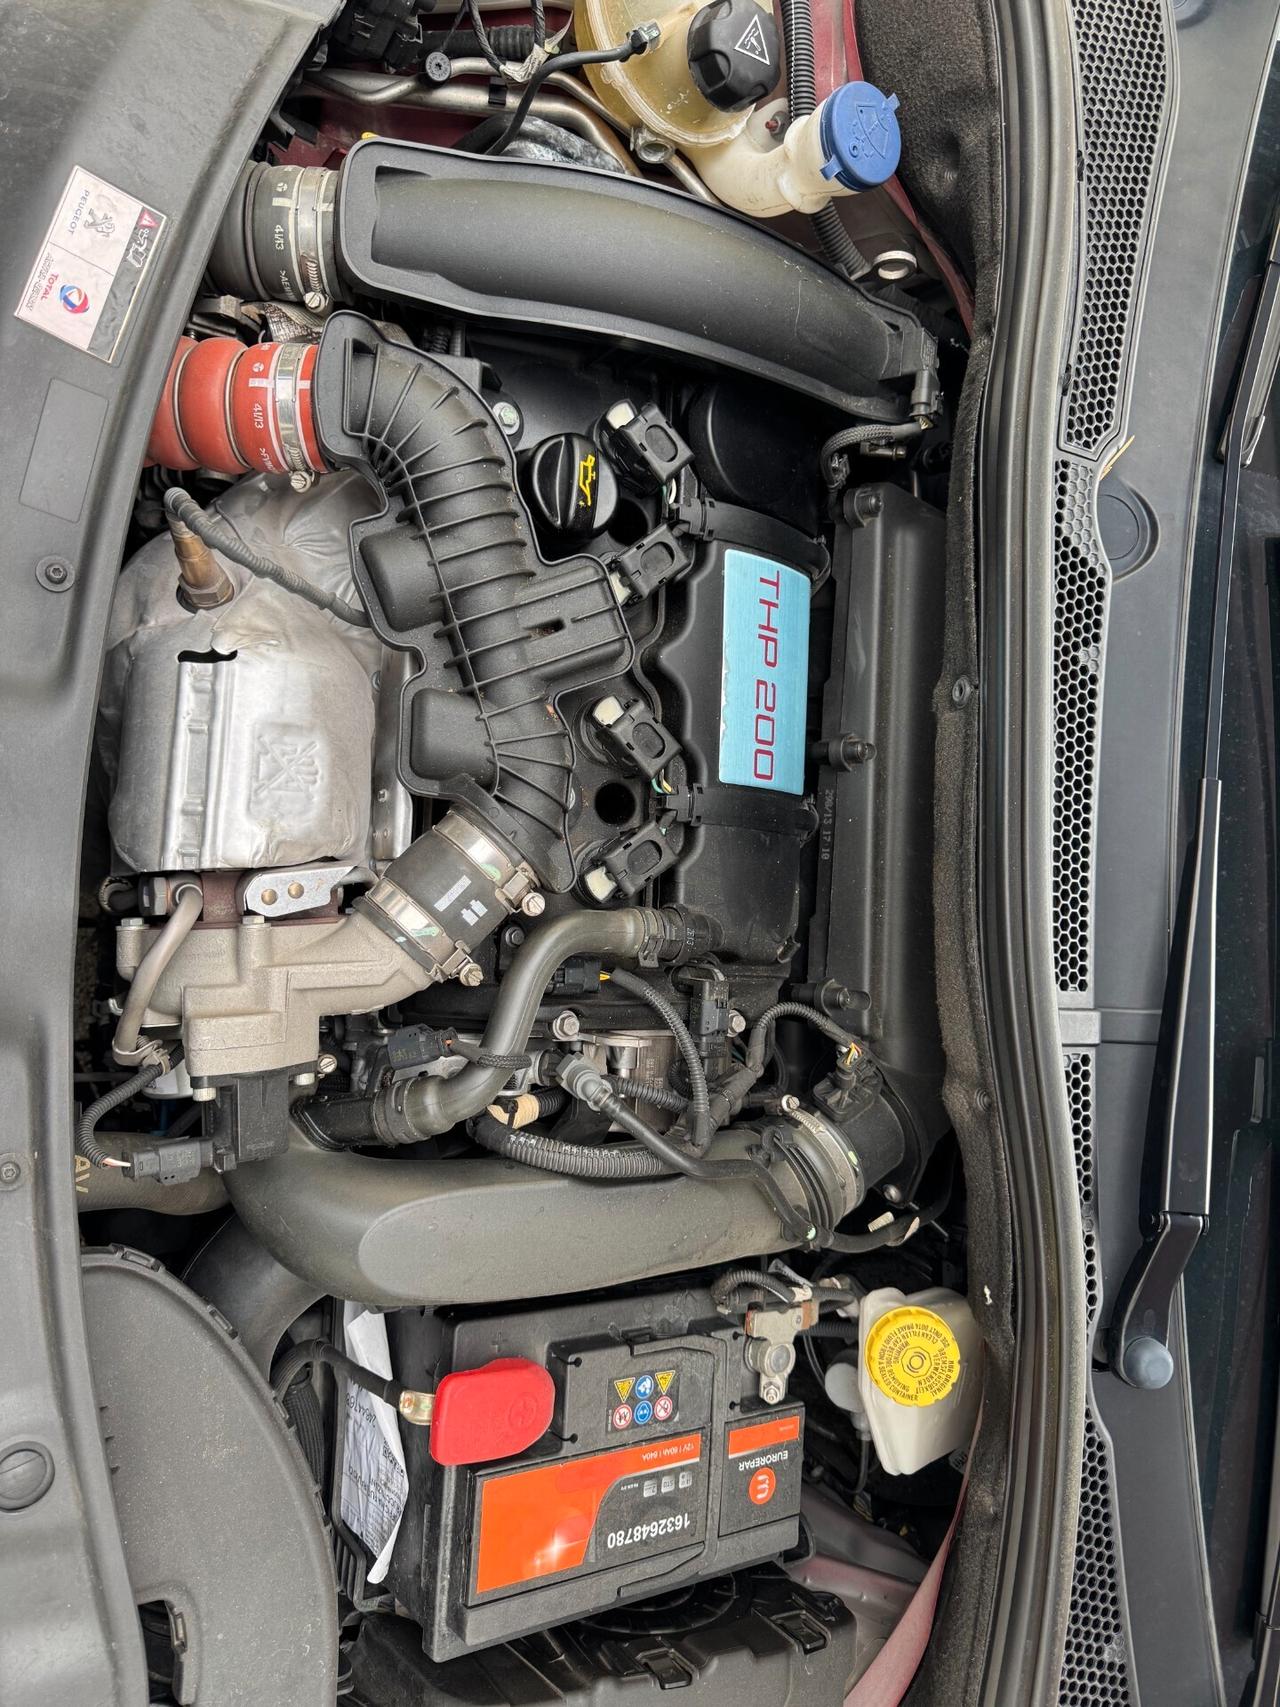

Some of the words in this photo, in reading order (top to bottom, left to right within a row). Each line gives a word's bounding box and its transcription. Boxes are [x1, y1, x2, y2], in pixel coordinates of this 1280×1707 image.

[68, 190, 90, 235] PEUGEOT
[41, 273, 59, 300] TOTAL
[253, 403, 263, 429] 41/13
[758, 570, 780, 668] THP
[754, 678, 776, 781] 200
[884, 1332, 898, 1343] FLUID
[897, 1323, 914, 1334] BRAKE
[902, 1330, 920, 1341] FILLER
[922, 1332, 938, 1344] CLEAN
[929, 1328, 942, 1338] ONLY
[878, 1344, 888, 1360] FROM
[894, 1337, 902, 1347] CAP
[879, 1366, 892, 1388] SEALED
[887, 1367, 910, 1392] REMOVING
[917, 1354, 940, 1386] VERWENDEN
[889, 1384, 918, 1401] CONTAINER
[930, 1374, 951, 1397] ORIGINAL
[682, 1442, 694, 1452] 12V
[738, 1450, 788, 1471] EUROREPAR
[607, 1512, 690, 1548] 1632648780
